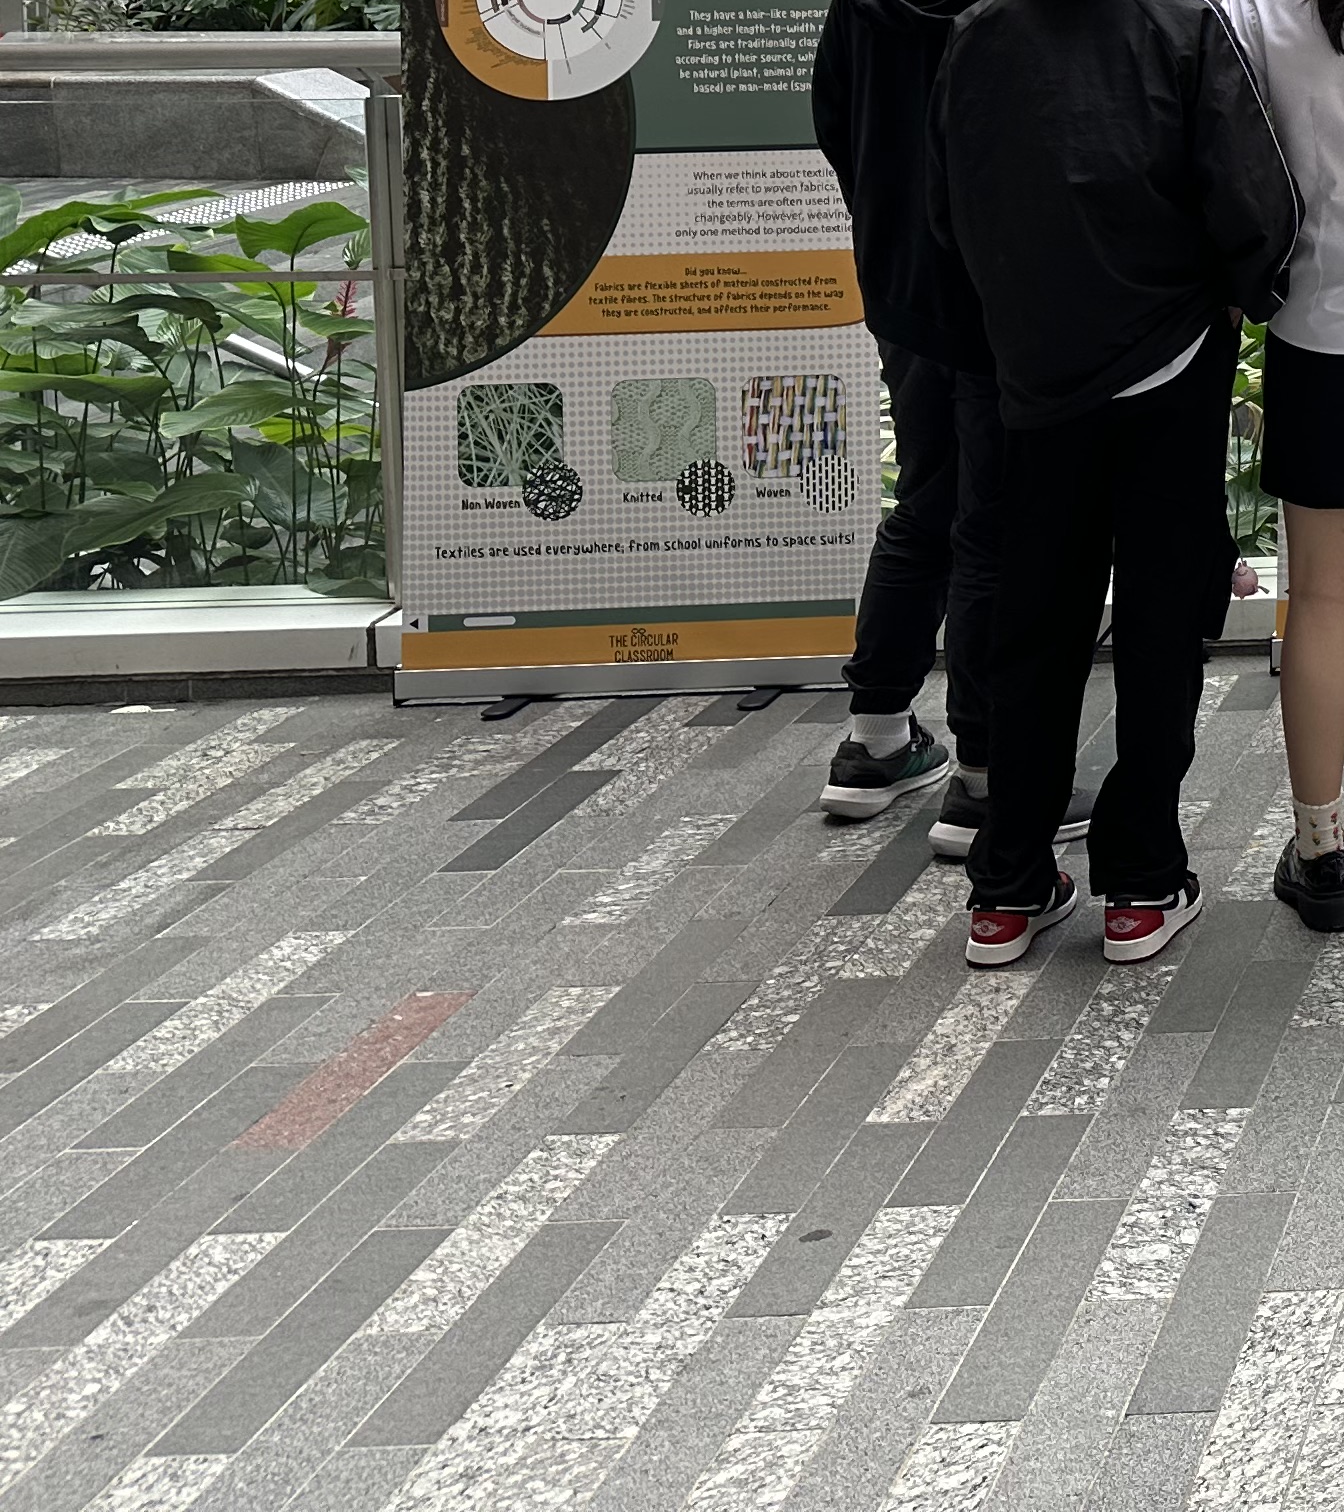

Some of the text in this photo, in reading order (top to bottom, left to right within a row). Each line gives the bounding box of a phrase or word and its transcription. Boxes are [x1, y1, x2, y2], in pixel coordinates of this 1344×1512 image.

[622, 491, 662, 502] Knitted
[755, 487, 791, 497] Woven
[460, 498, 520, 511] Non Woven
[435, 546, 484, 559] Textiles
[489, 547, 509, 557] are
[514, 544, 541, 556] used
[629, 540, 660, 552] from
[664, 538, 701, 551] school
[705, 536, 761, 549] uniforms
[766, 535, 778, 547] to
[783, 536, 816, 547] space
[819, 532, 854, 545] suits!
[609, 632, 679, 647] THE CIRCULAR
[614, 648, 674, 662] CLASSROOM
